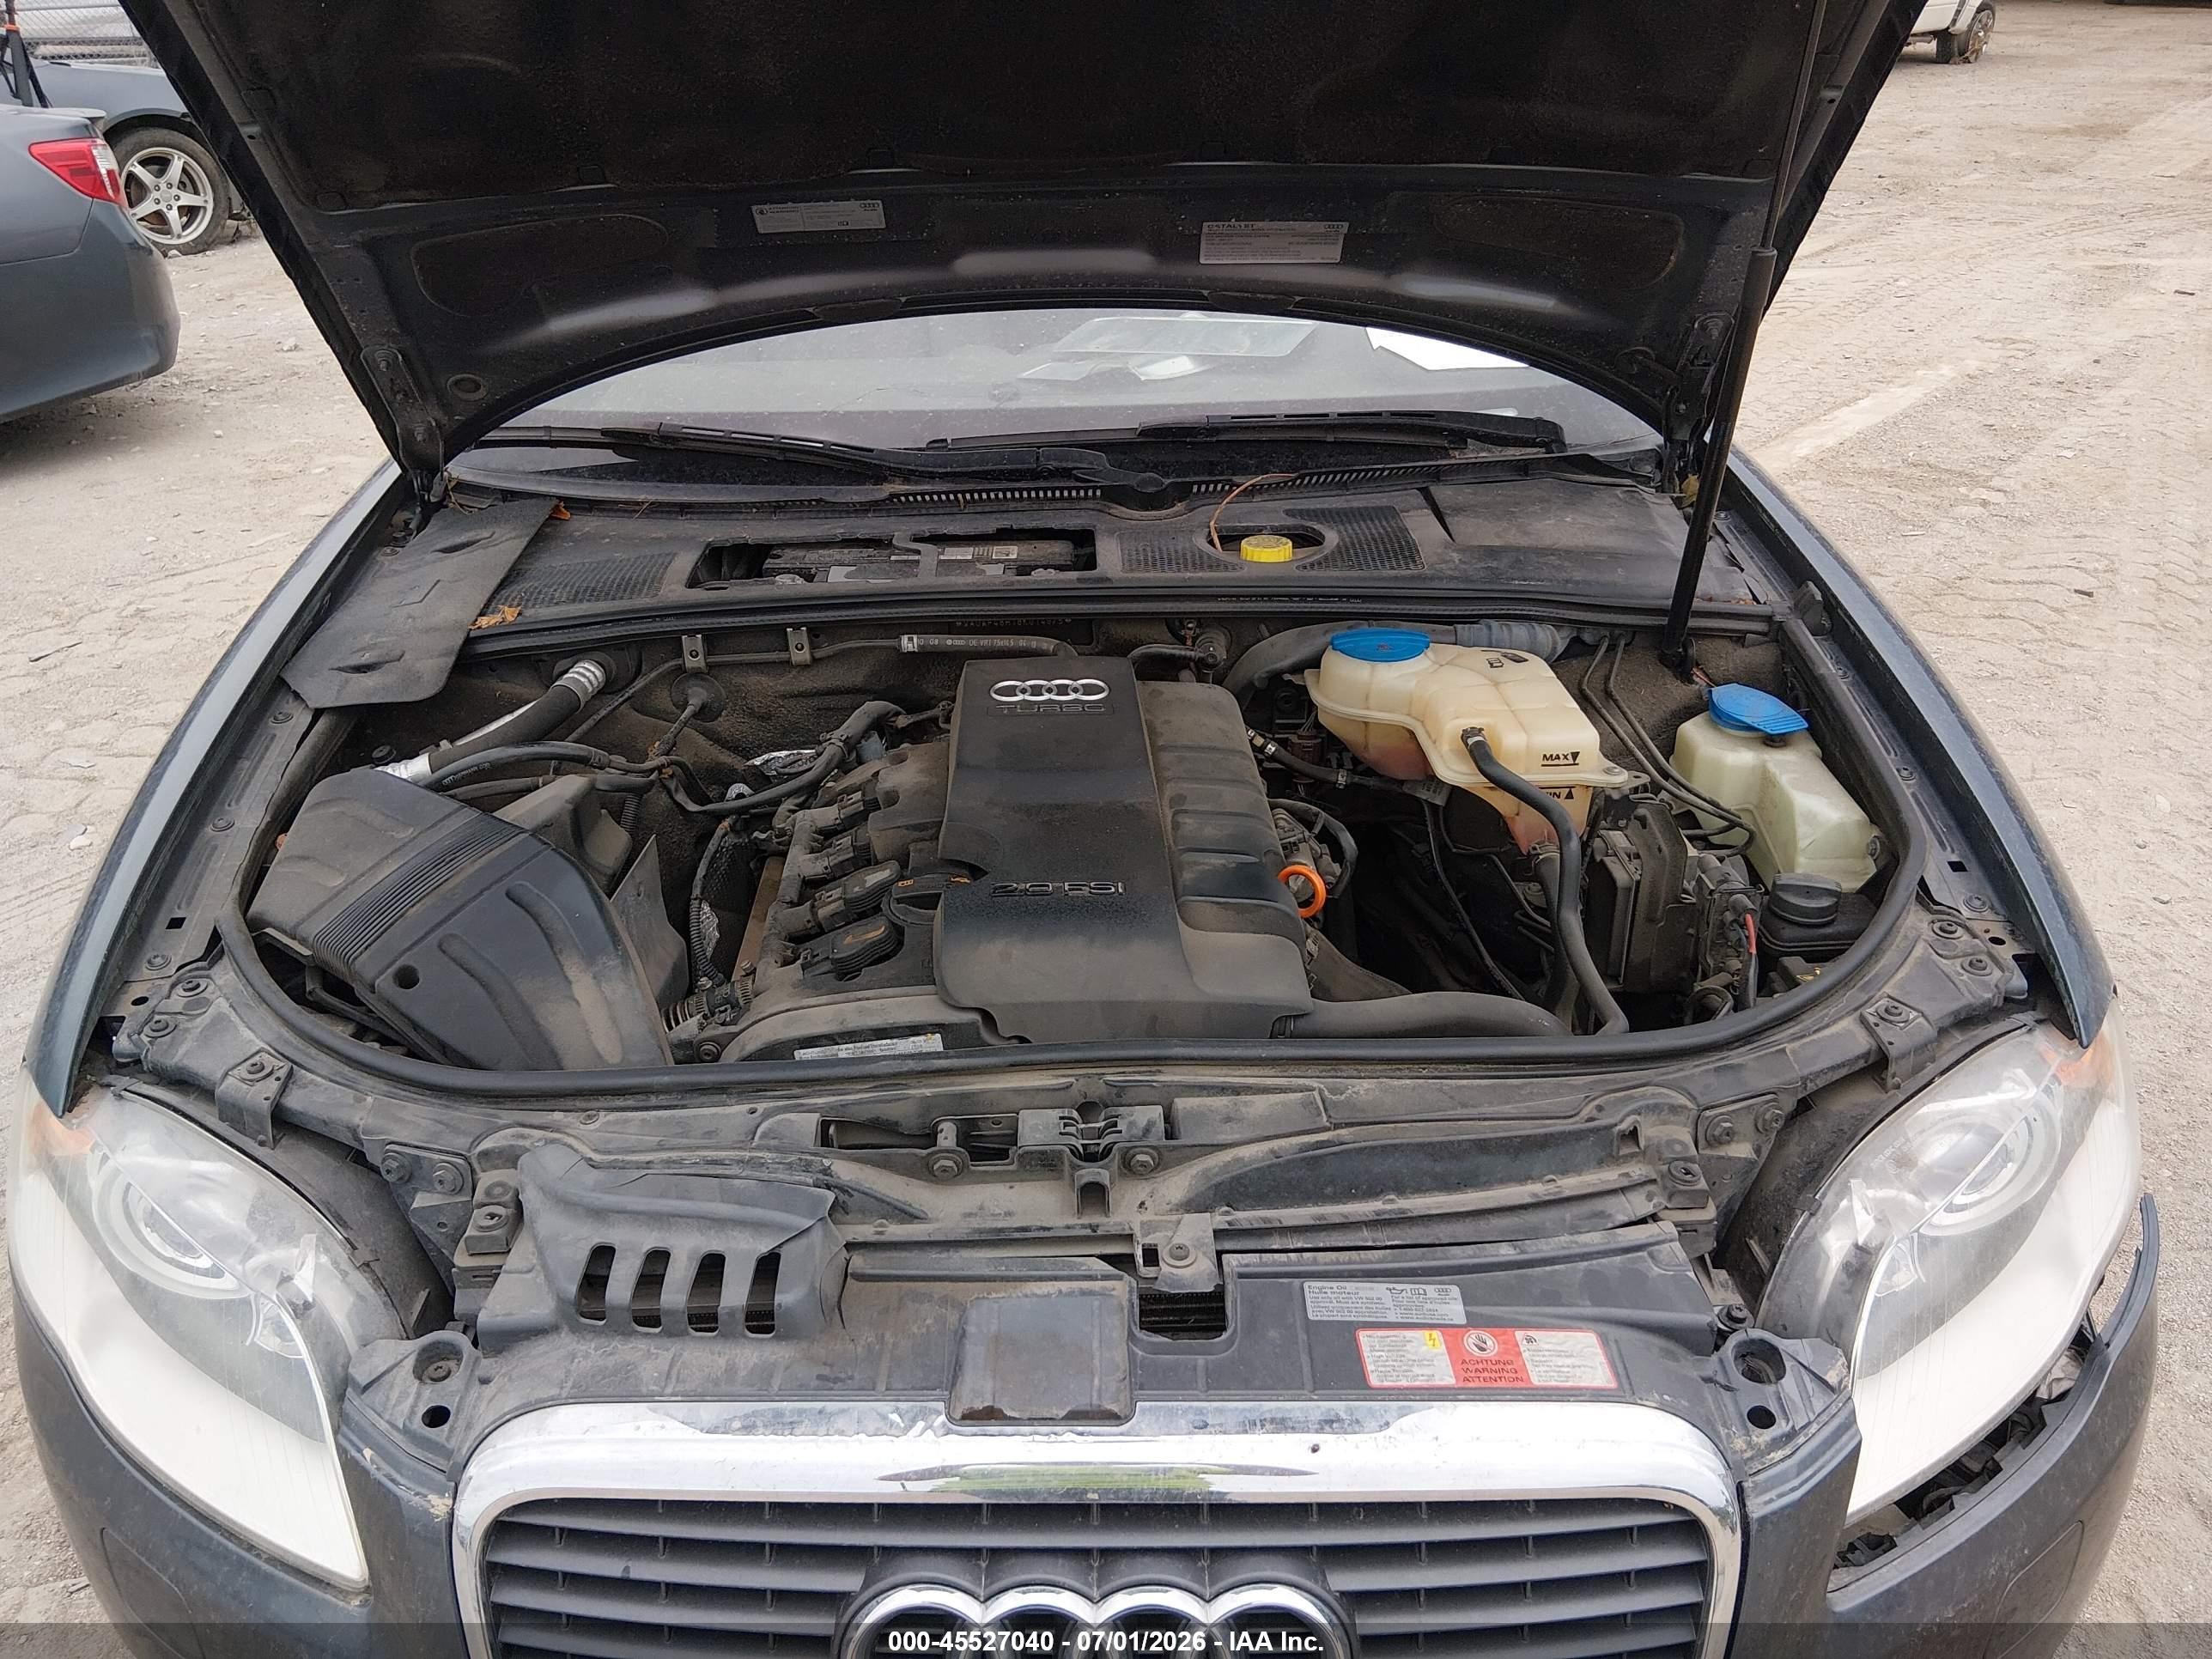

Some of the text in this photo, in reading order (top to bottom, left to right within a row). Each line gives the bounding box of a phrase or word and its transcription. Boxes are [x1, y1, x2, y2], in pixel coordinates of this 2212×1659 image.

[996, 703, 1105, 714] TURBO
[1542, 753, 1570, 762] MAX
[991, 881, 1126, 897] 2.0 FSI
